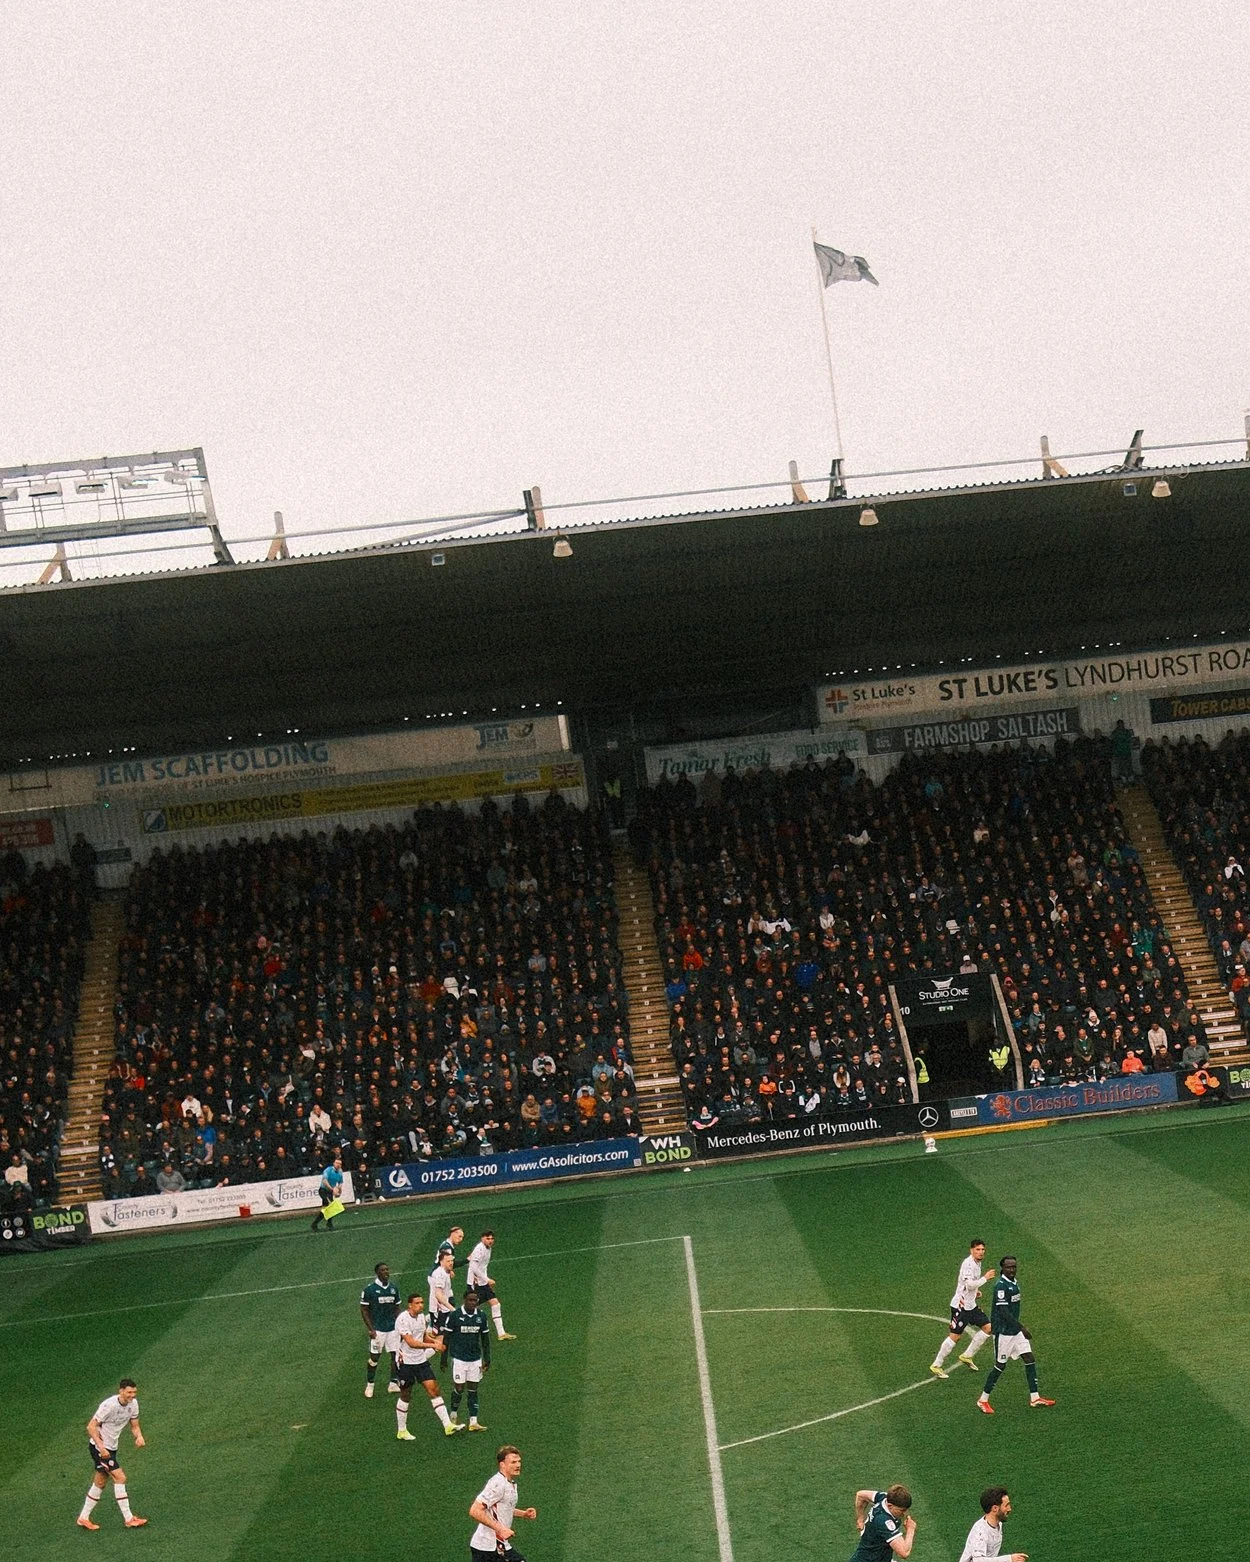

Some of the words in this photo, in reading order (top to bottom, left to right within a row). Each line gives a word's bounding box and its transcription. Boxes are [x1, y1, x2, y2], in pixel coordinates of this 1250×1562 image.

[939, 678, 967, 700] ST
[975, 669, 1058, 697] LUKE'S
[1065, 653, 1202, 688] LYNDHURST
[852, 688, 867, 701] St
[872, 683, 916, 699] Luke's
[1171, 697, 1218, 717] TOWER
[903, 721, 990, 748] FARMSHOP
[998, 712, 1069, 738] SALTASH
[97, 762, 146, 788] JEM
[152, 742, 329, 780] SCAFFOLDING
[659, 756, 720, 776] Tamar
[724, 748, 771, 769] Fresh
[169, 794, 302, 822] MOTORTRONICS
[918, 990, 950, 1000] STUDIO
[950, 987, 970, 996] ONE
[1014, 1092, 1078, 1114] Classic
[1083, 1081, 1161, 1106] Builders
[650, 1136, 681, 1150] WH
[707, 1128, 800, 1149] Mercedes-Benz
[803, 1124, 815, 1136] of
[819, 1117, 882, 1136] Plymouth.
[421, 1169, 455, 1184] 01752
[457, 1164, 498, 1179] 203500
[512, 1149, 629, 1173] www.GAsolicitors.com
[645, 1147, 691, 1164] BOND
[33, 1210, 85, 1230] BOND
[113, 1203, 166, 1221] Fasteners
